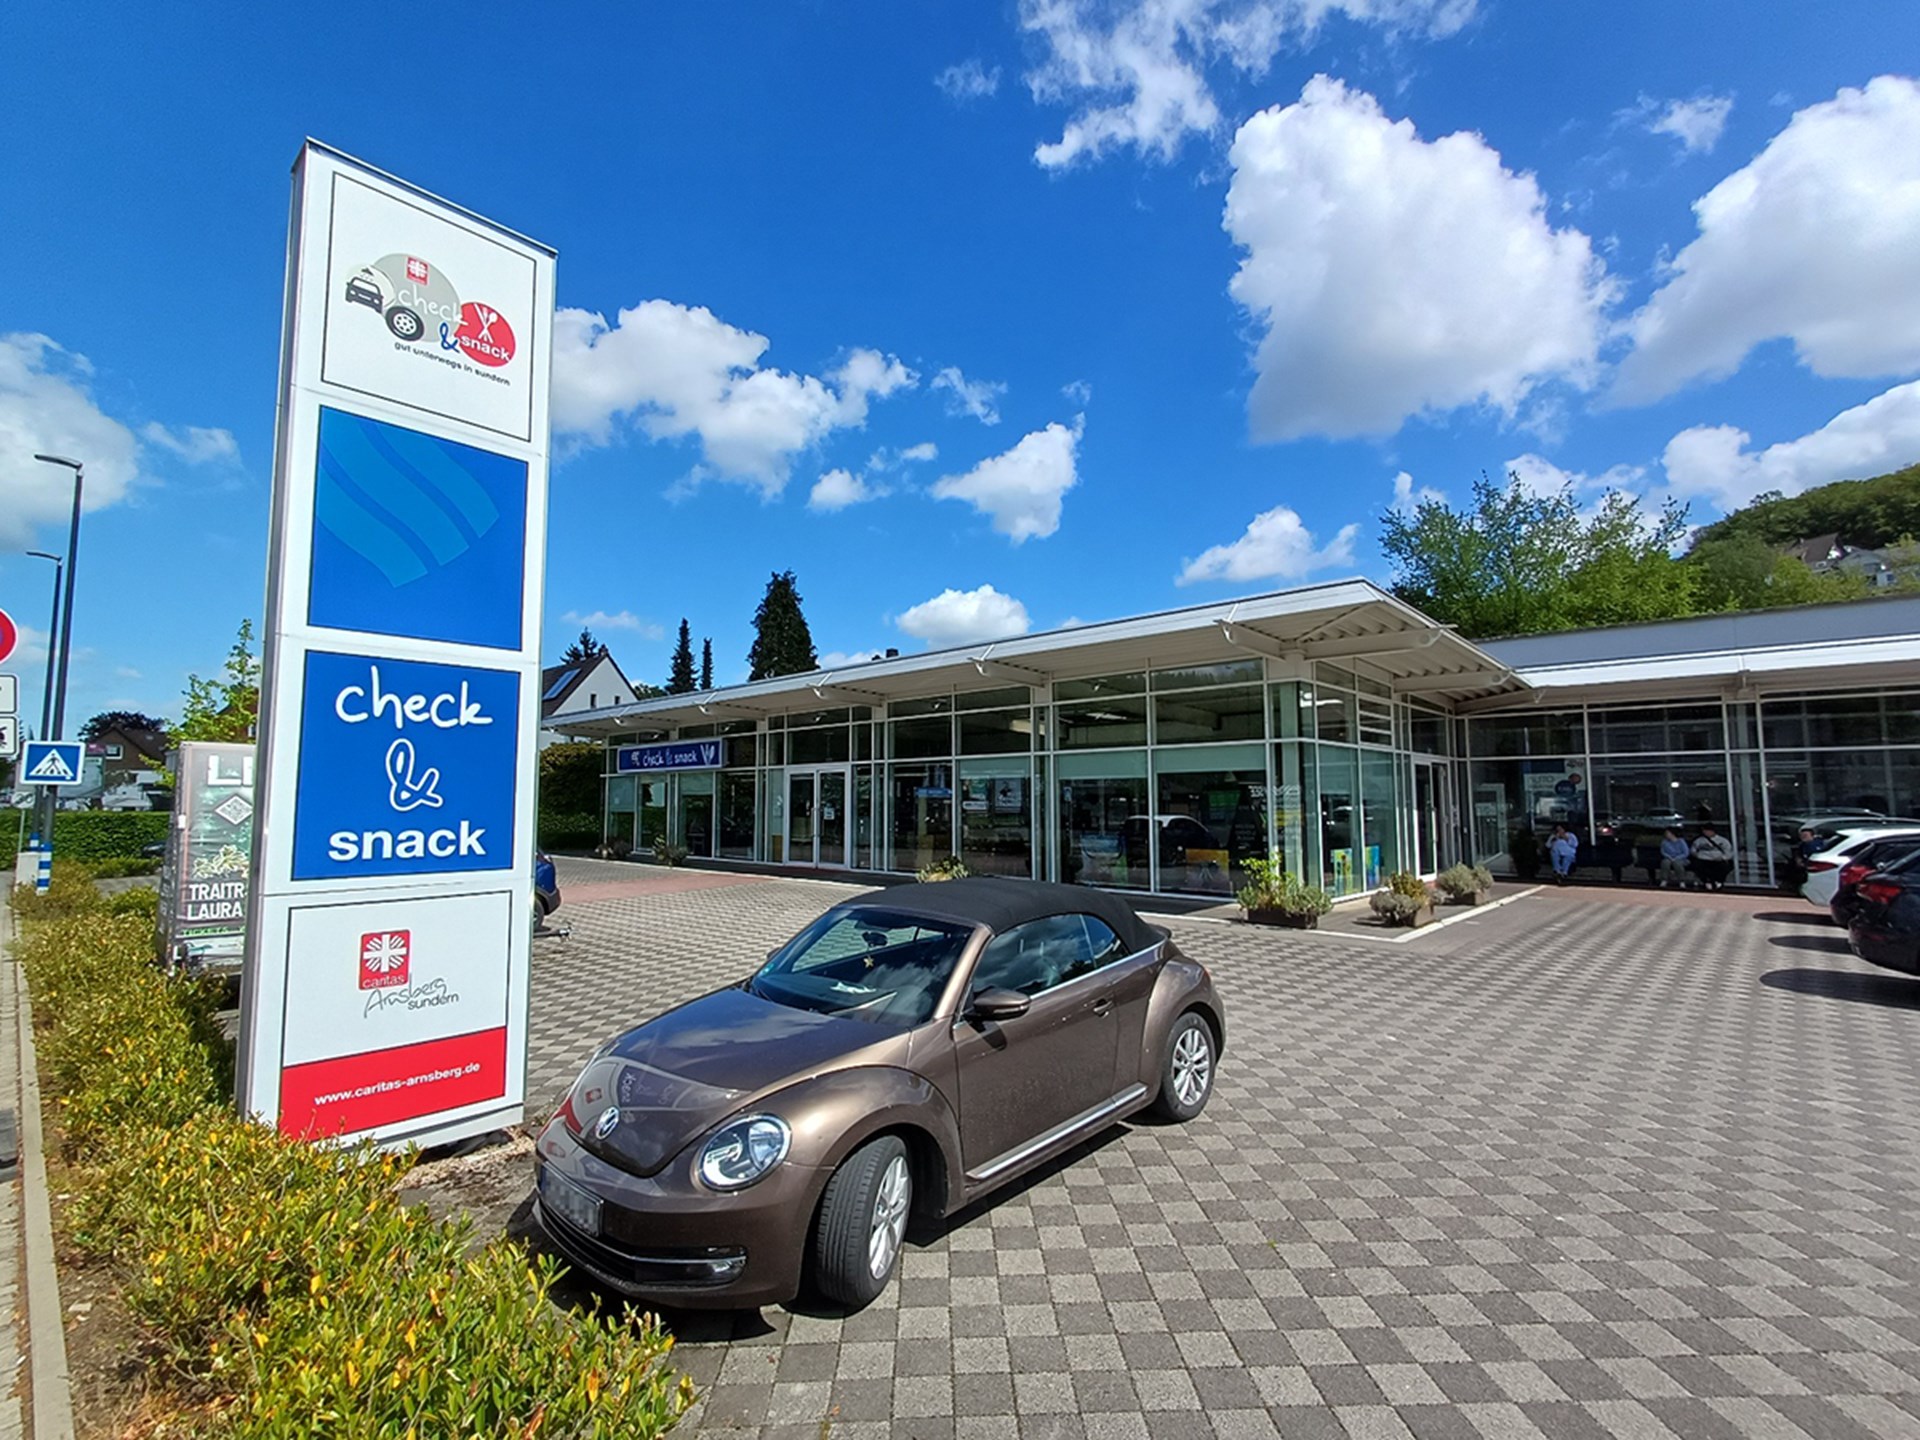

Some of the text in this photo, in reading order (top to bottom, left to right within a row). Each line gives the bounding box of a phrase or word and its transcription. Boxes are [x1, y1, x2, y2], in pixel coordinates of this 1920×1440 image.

[398, 285, 469, 326] check
[394, 342, 411, 353] gut
[440, 321, 512, 363] & snack
[335, 665, 494, 729] check
[385, 738, 444, 812] &
[642, 750, 664, 766] check
[674, 750, 697, 764] snack
[328, 820, 487, 861] snack
[187, 901, 243, 920] LAURA
[362, 975, 405, 988] caritas
[363, 973, 447, 1019] Arnsberg
[407, 993, 460, 1010] sundern
[313, 1062, 481, 1105] www.caritas-arnsberg.de
